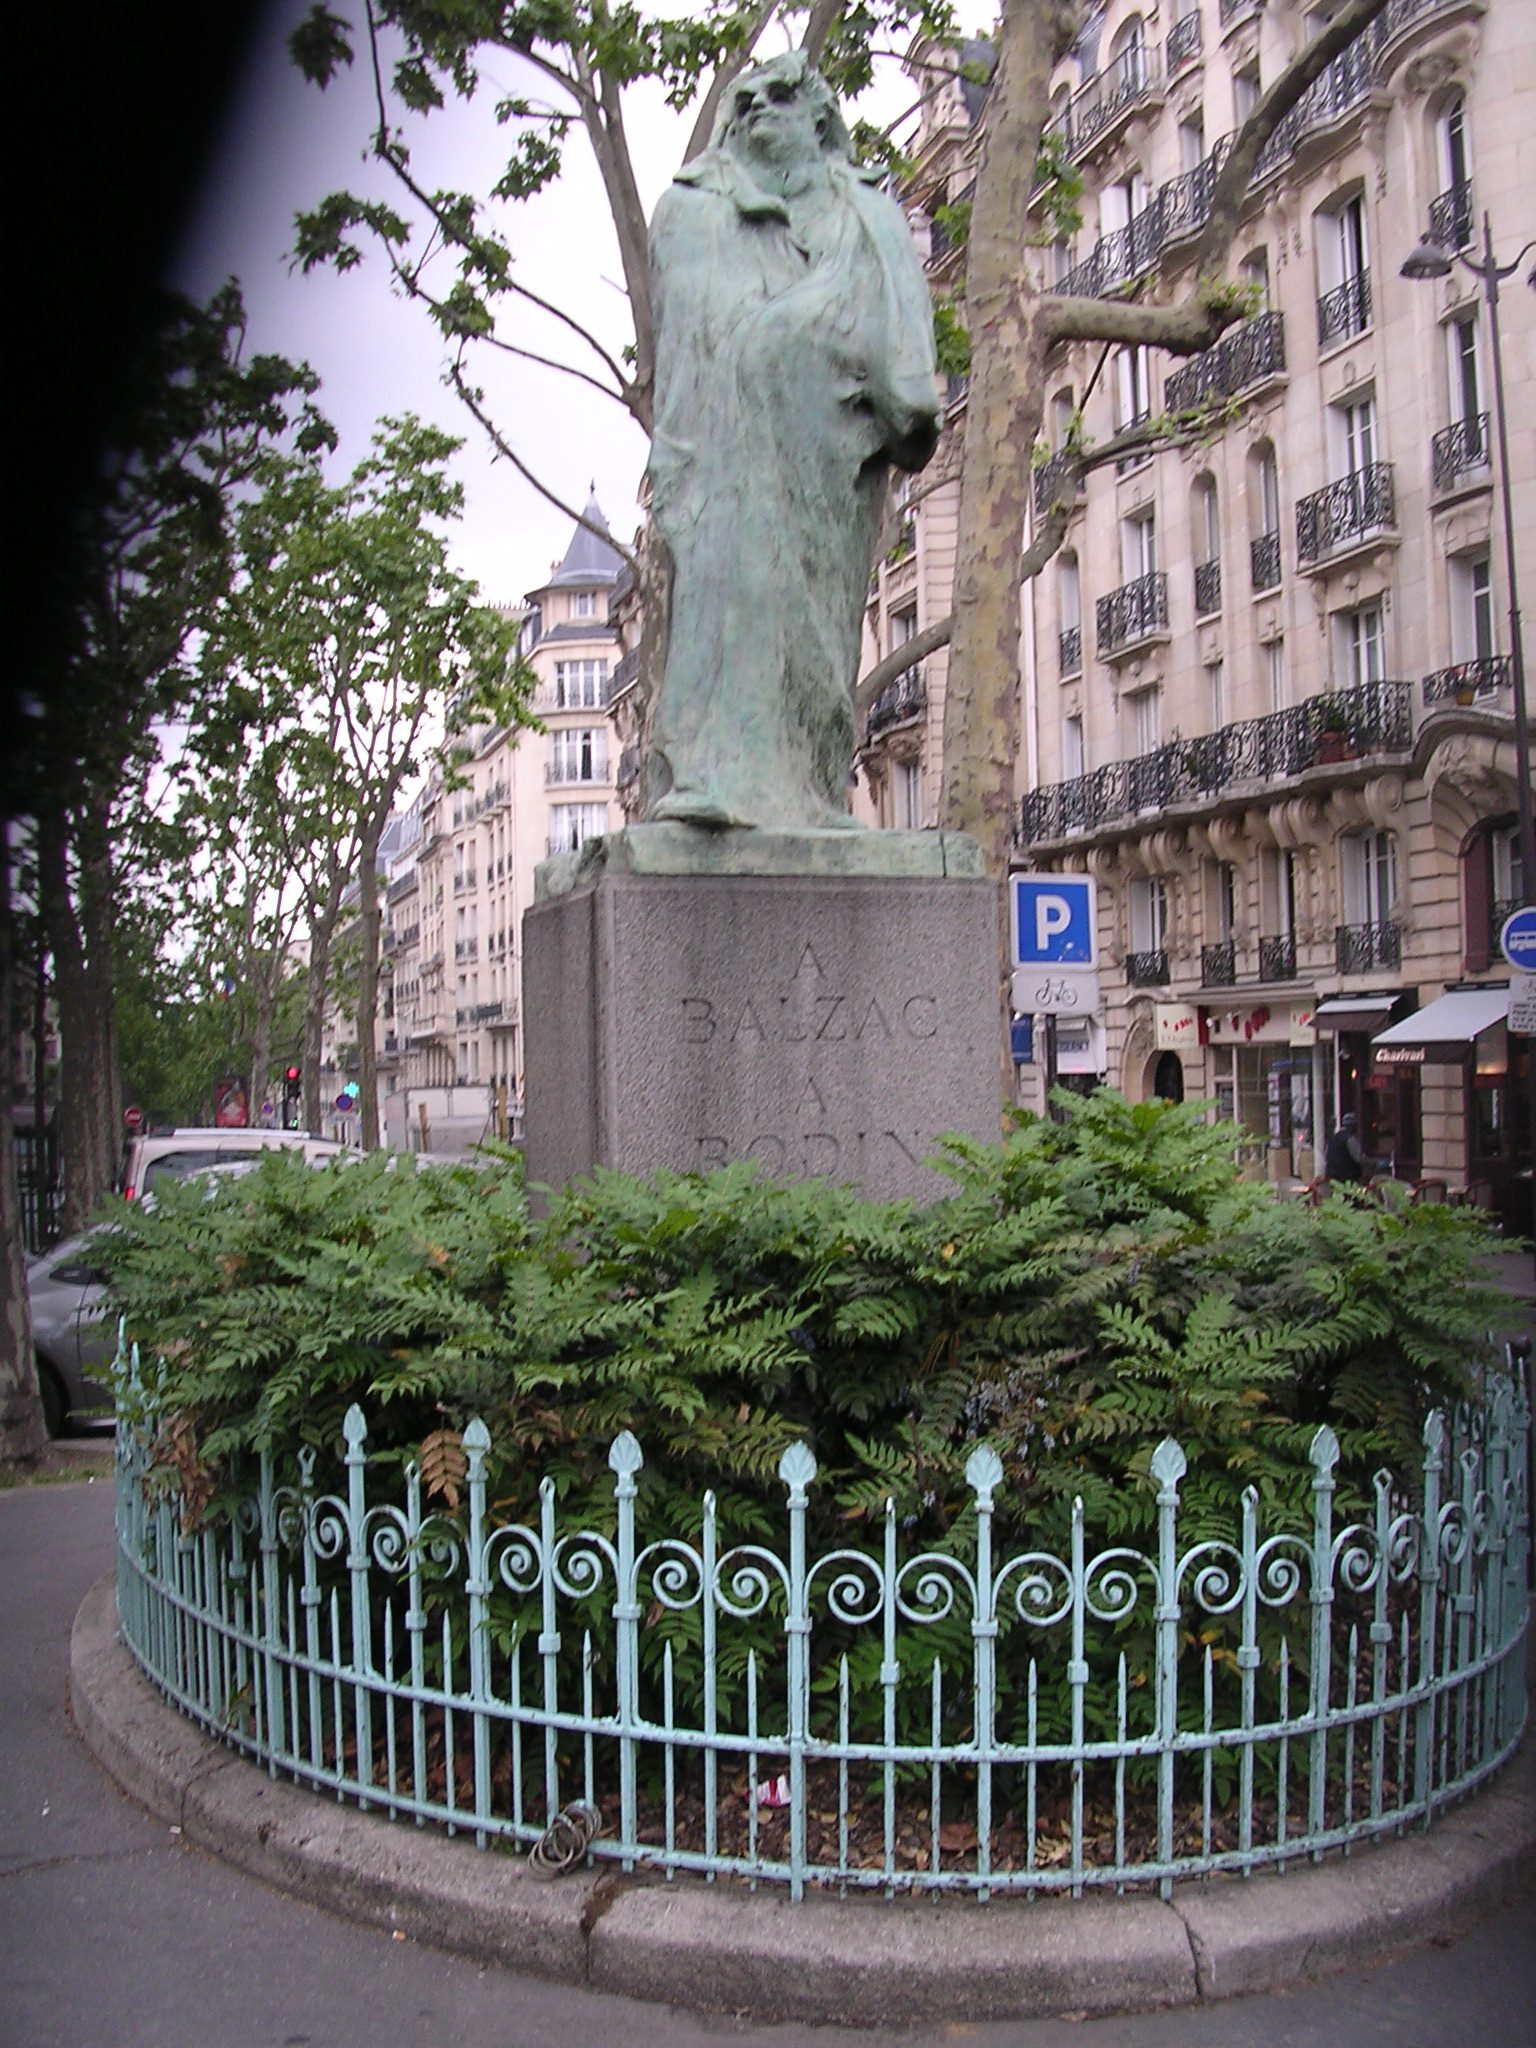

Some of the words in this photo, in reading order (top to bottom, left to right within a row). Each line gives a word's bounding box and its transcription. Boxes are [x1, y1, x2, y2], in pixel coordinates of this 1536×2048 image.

[1036, 895, 1071, 951] P
[790, 941, 827, 980] A
[680, 994, 938, 1044] BALZAC
[795, 1075, 827, 1114] A
